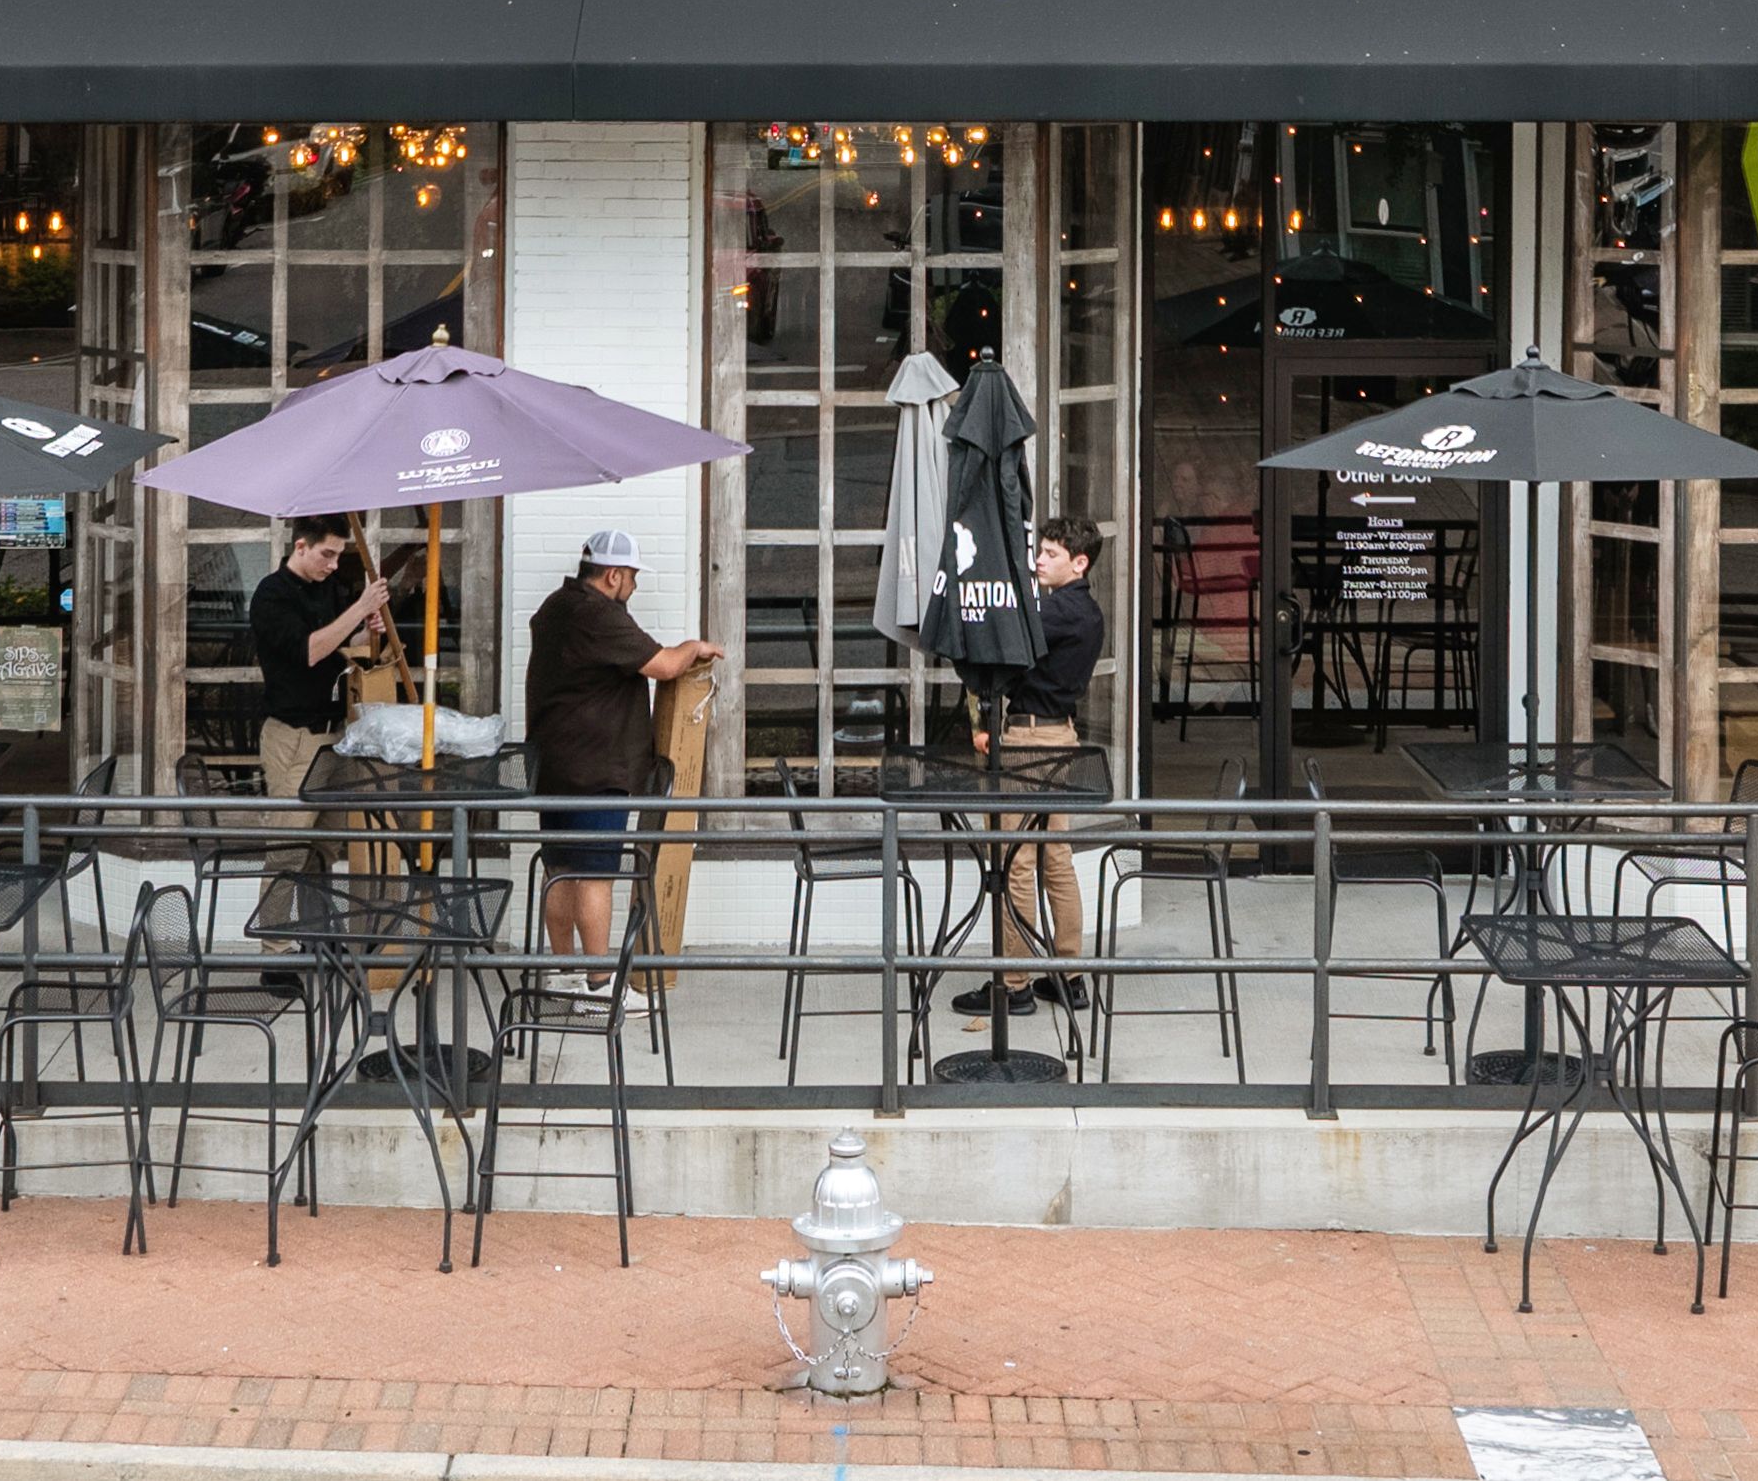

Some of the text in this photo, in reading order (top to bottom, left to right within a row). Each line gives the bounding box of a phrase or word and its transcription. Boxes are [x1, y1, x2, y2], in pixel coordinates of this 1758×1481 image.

[1355, 441, 1498, 464] REFORMATION
[396, 458, 501, 480] LUNAZUL
[1367, 516, 1404, 527] Hours
[1361, 555, 1410, 565] THURSDAY
